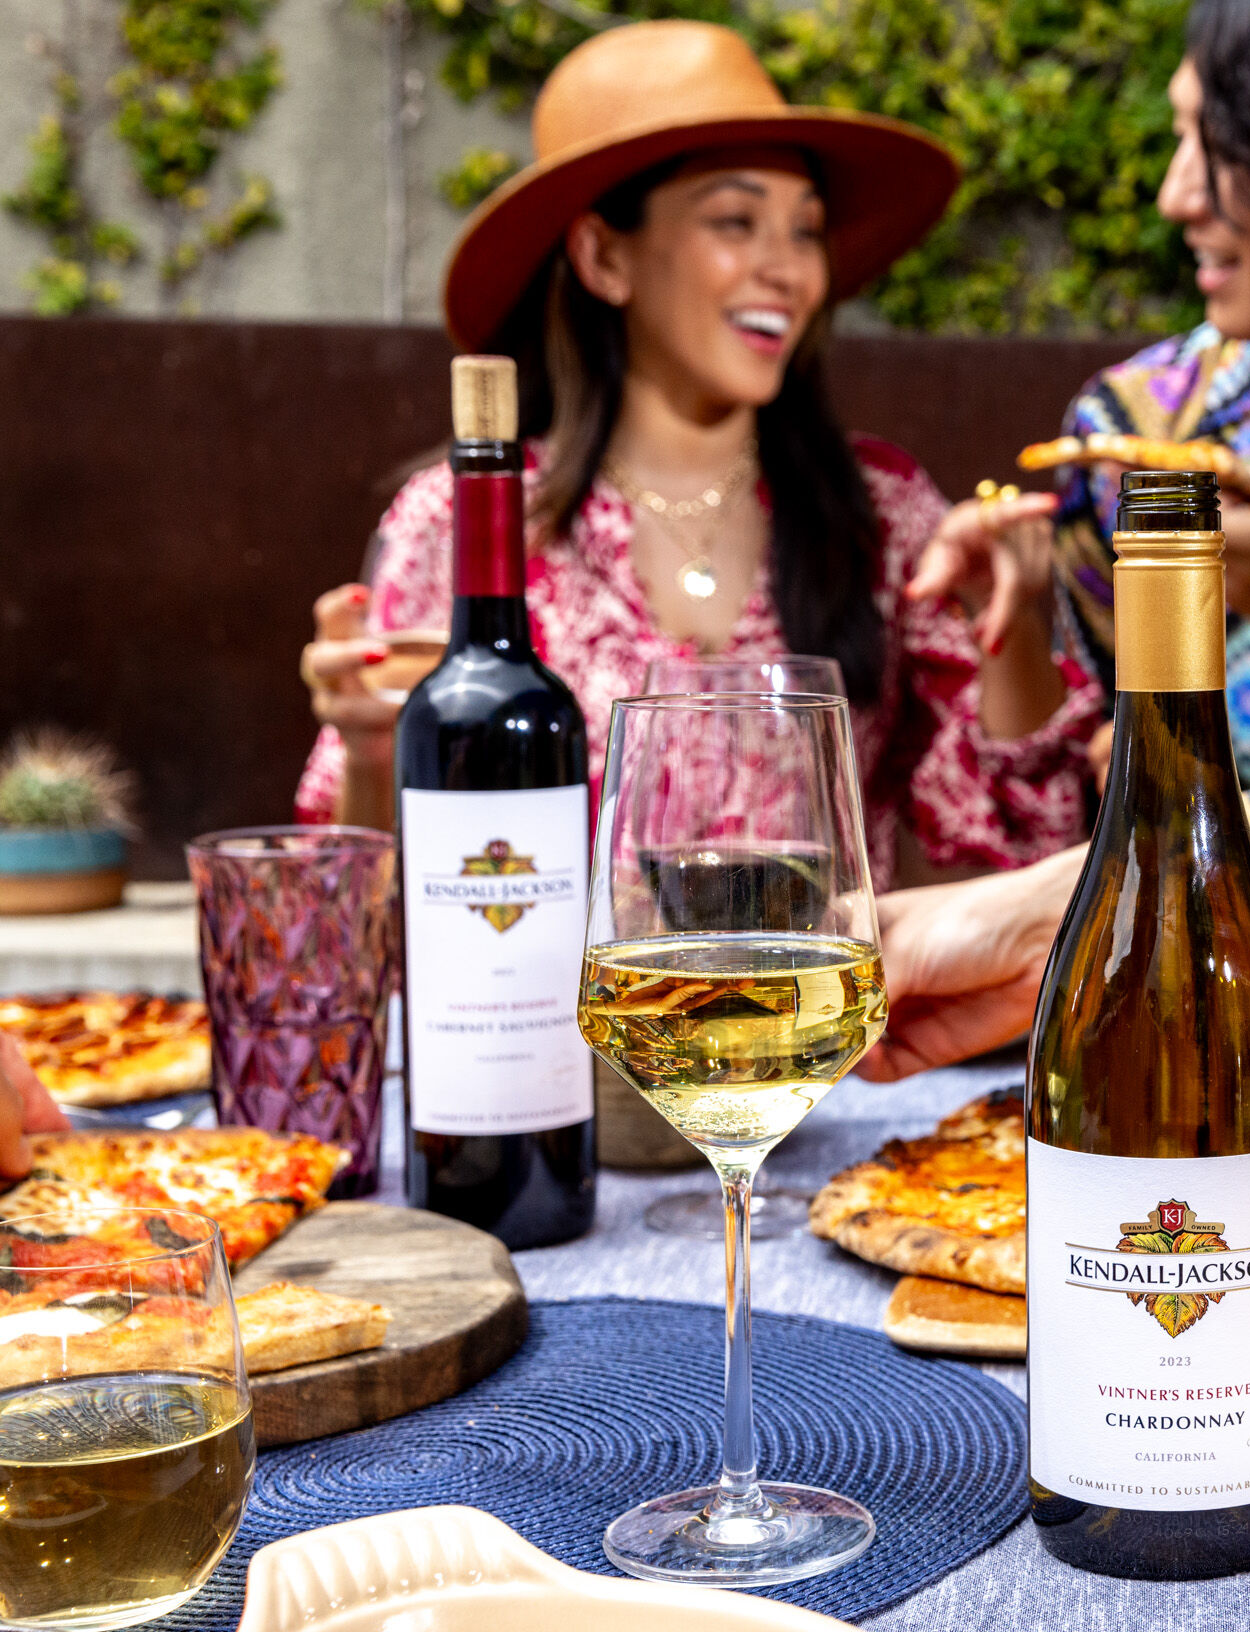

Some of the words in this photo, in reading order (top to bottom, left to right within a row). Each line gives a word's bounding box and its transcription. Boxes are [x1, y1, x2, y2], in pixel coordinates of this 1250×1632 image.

[1159, 1356, 1192, 1367] 2023
[1098, 1384, 1180, 1401] VINTNER'S
[1105, 1410, 1245, 1430] CHARDONNAY
[1135, 1451, 1217, 1462] CALIFORNIA
[1068, 1474, 1144, 1495] COMMITTED
[1151, 1486, 1169, 1496] TO
